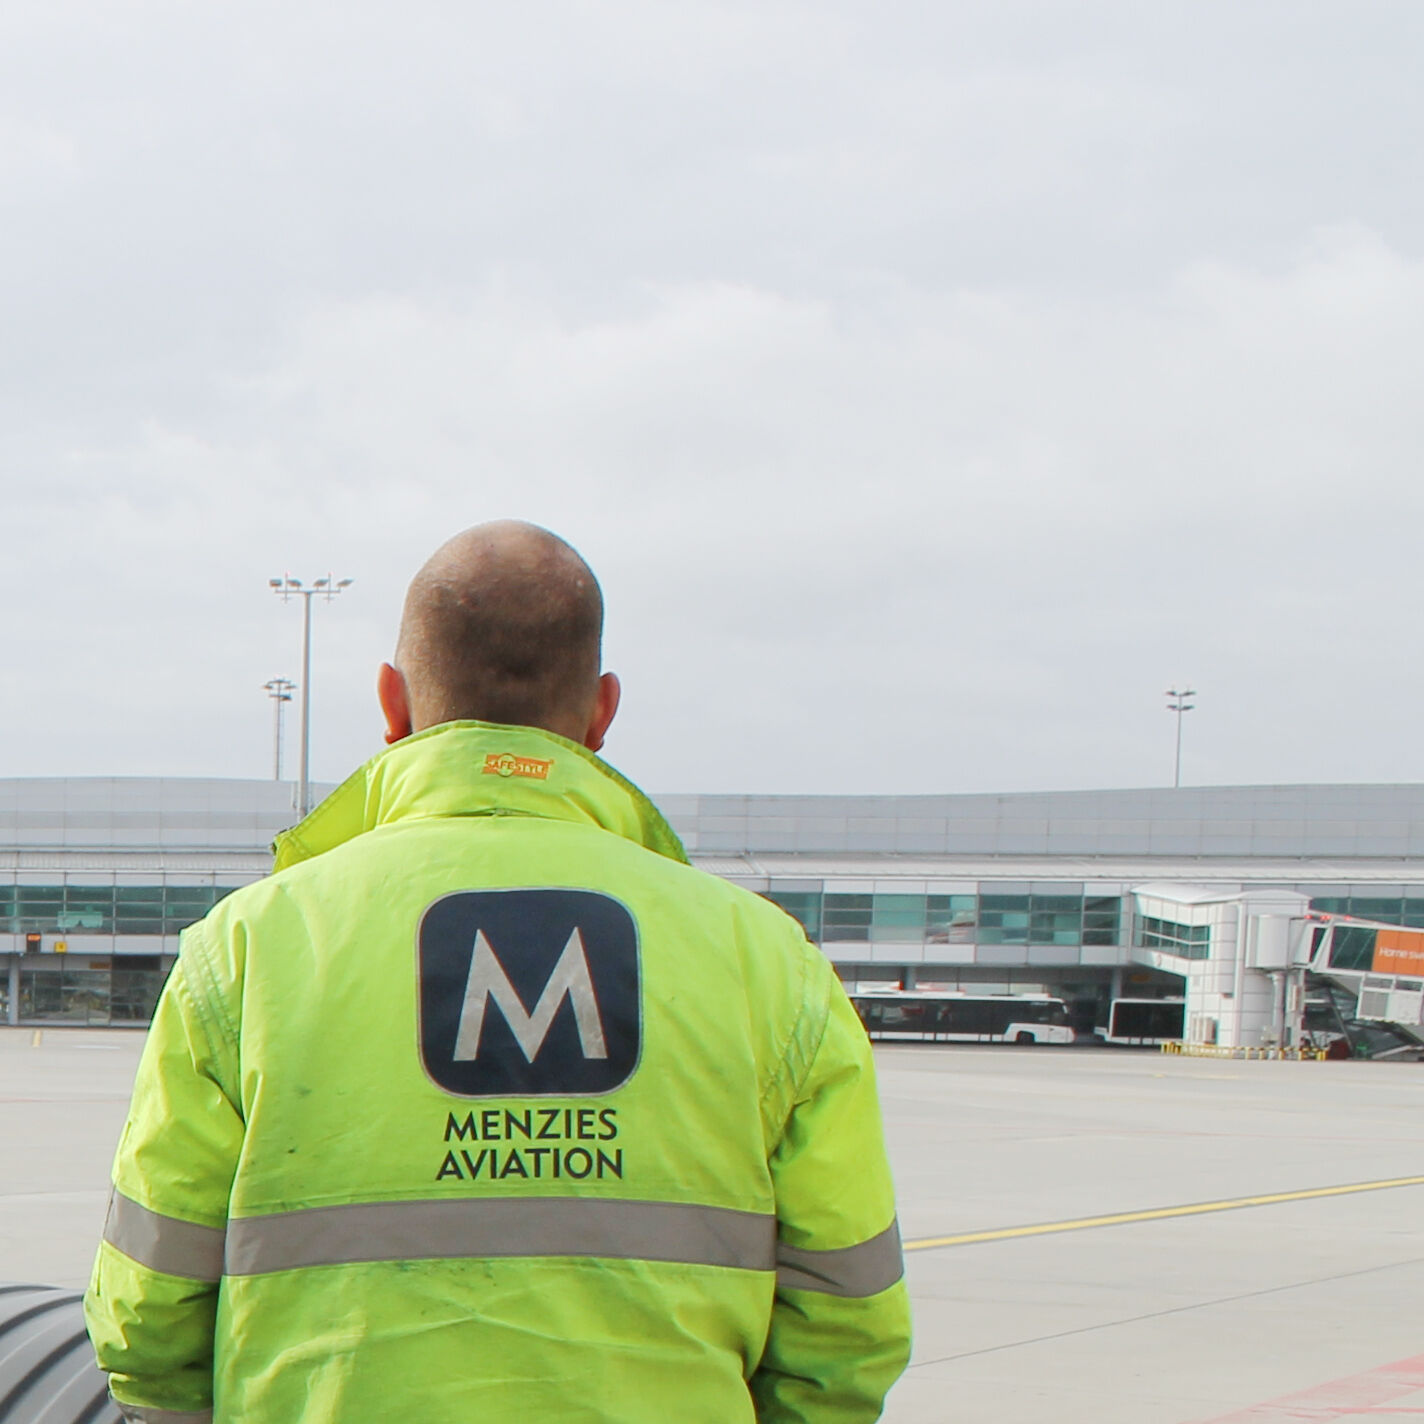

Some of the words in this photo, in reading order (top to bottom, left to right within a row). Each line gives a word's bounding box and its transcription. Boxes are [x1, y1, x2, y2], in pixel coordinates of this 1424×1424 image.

[453, 926, 608, 1064] M
[444, 1108, 618, 1142] MENZIES
[436, 1146, 624, 1181] AVIATION
